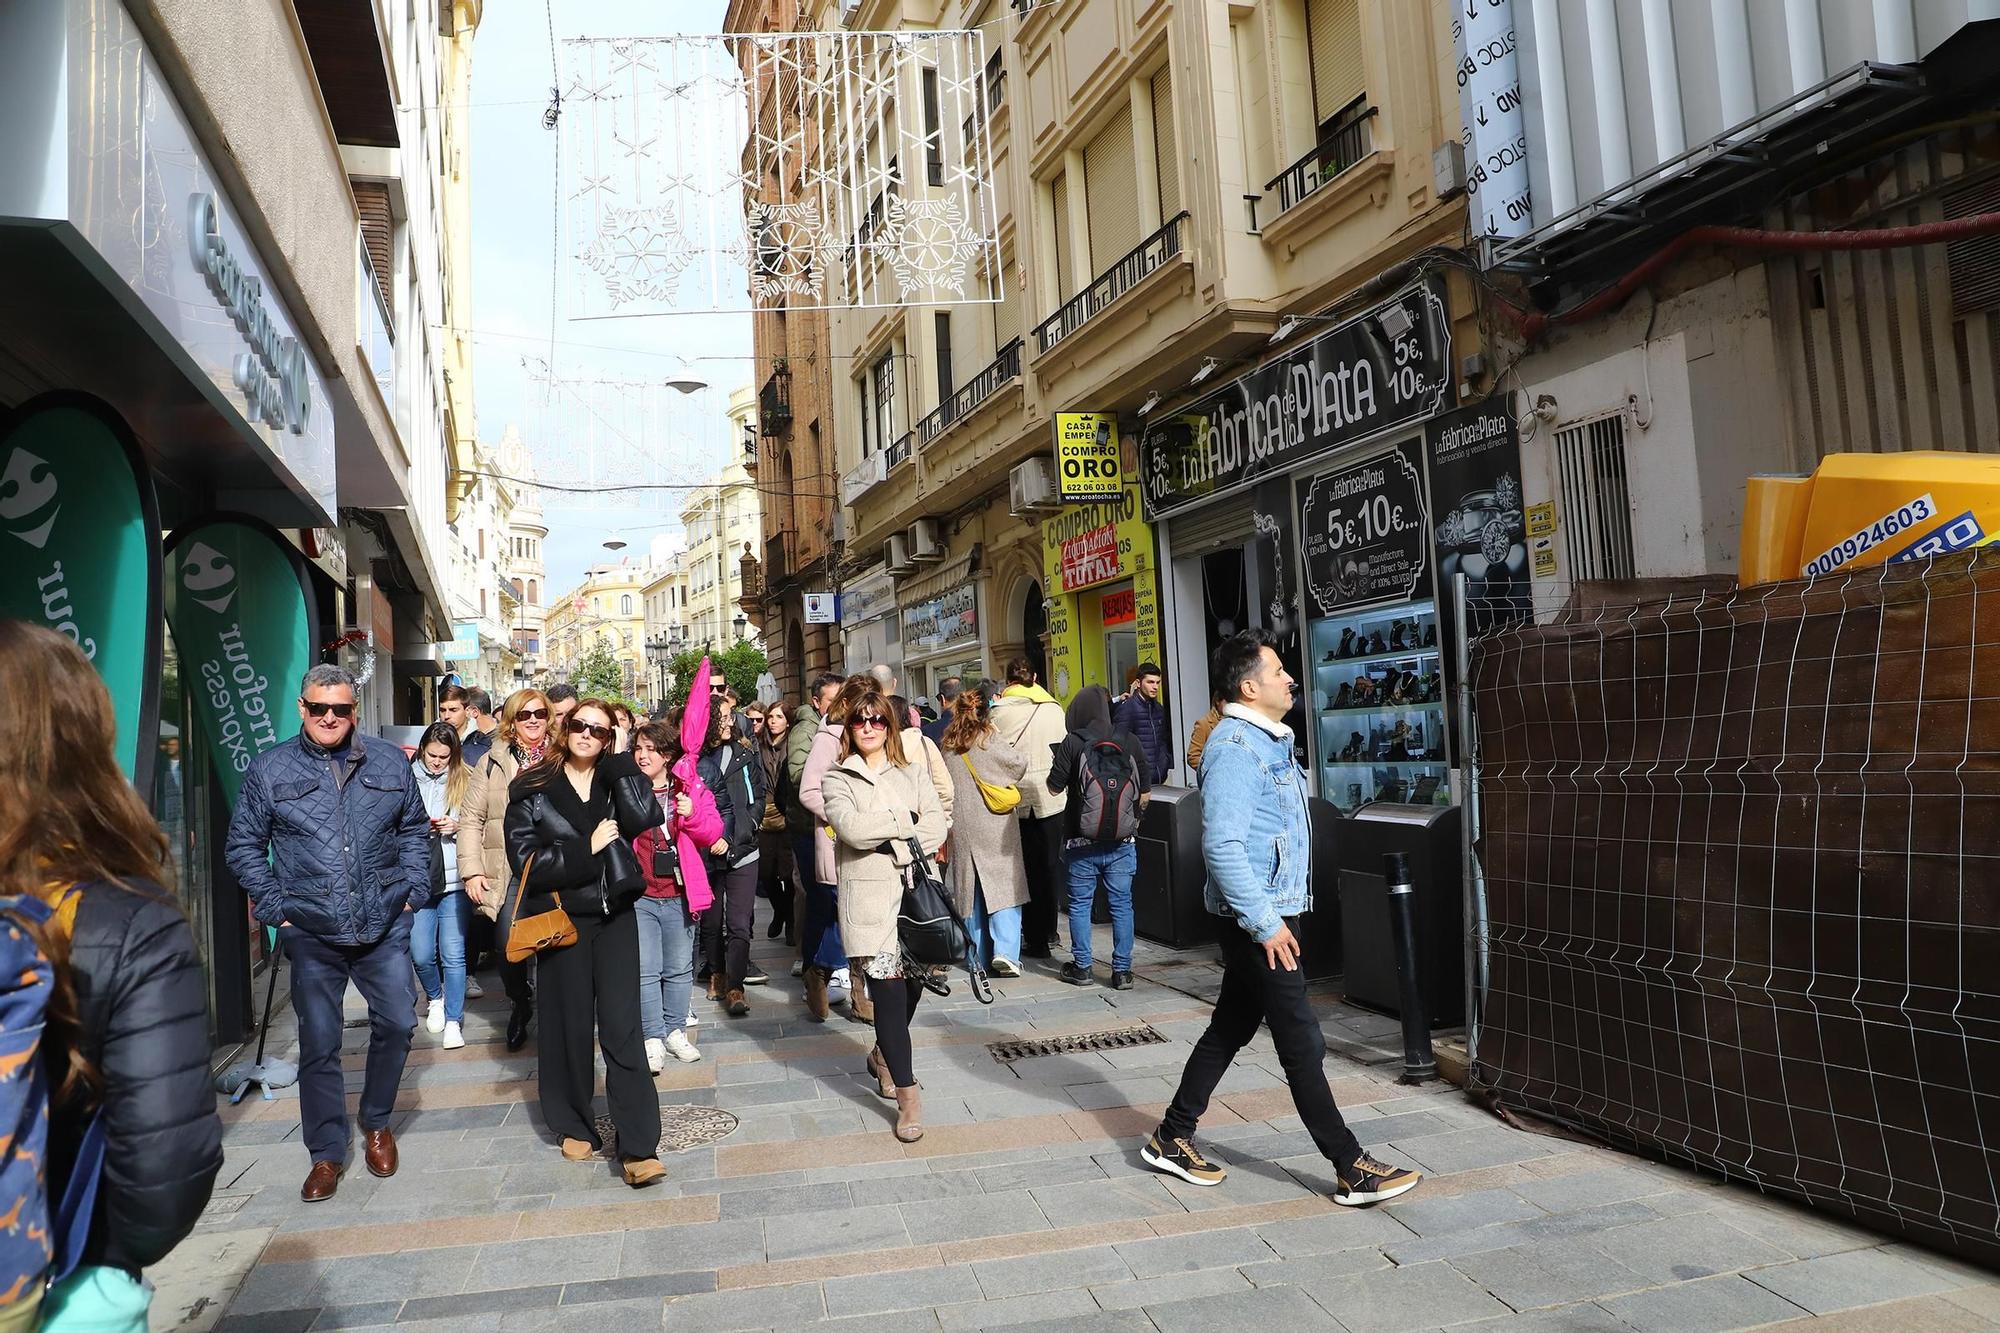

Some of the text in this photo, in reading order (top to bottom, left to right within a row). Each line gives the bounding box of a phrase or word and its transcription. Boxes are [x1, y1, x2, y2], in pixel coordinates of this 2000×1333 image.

[1282, 389, 1296, 415] de
[1284, 418, 1297, 448] la
[1062, 446, 1116, 456] COMPRO
[1063, 459, 1117, 478] ORO
[1182, 454, 1200, 489] La
[1107, 483, 1117, 491] 08
[1048, 504, 1100, 549] COMPRO
[1104, 488, 1134, 524] ORO
[1806, 499, 1930, 576] 900924603
[1065, 556, 1117, 588] TOTAL
[1370, 565, 1380, 576] and
[1380, 563, 1397, 574] Direct
[1370, 578, 1377, 589] of
[1140, 604, 1154, 615] ORO
[1051, 619, 1068, 635] ORO
[1137, 618, 1154, 628] MEJOR
[1138, 628, 1155, 637] PRECIO
[1053, 646, 1069, 656] PLATA
